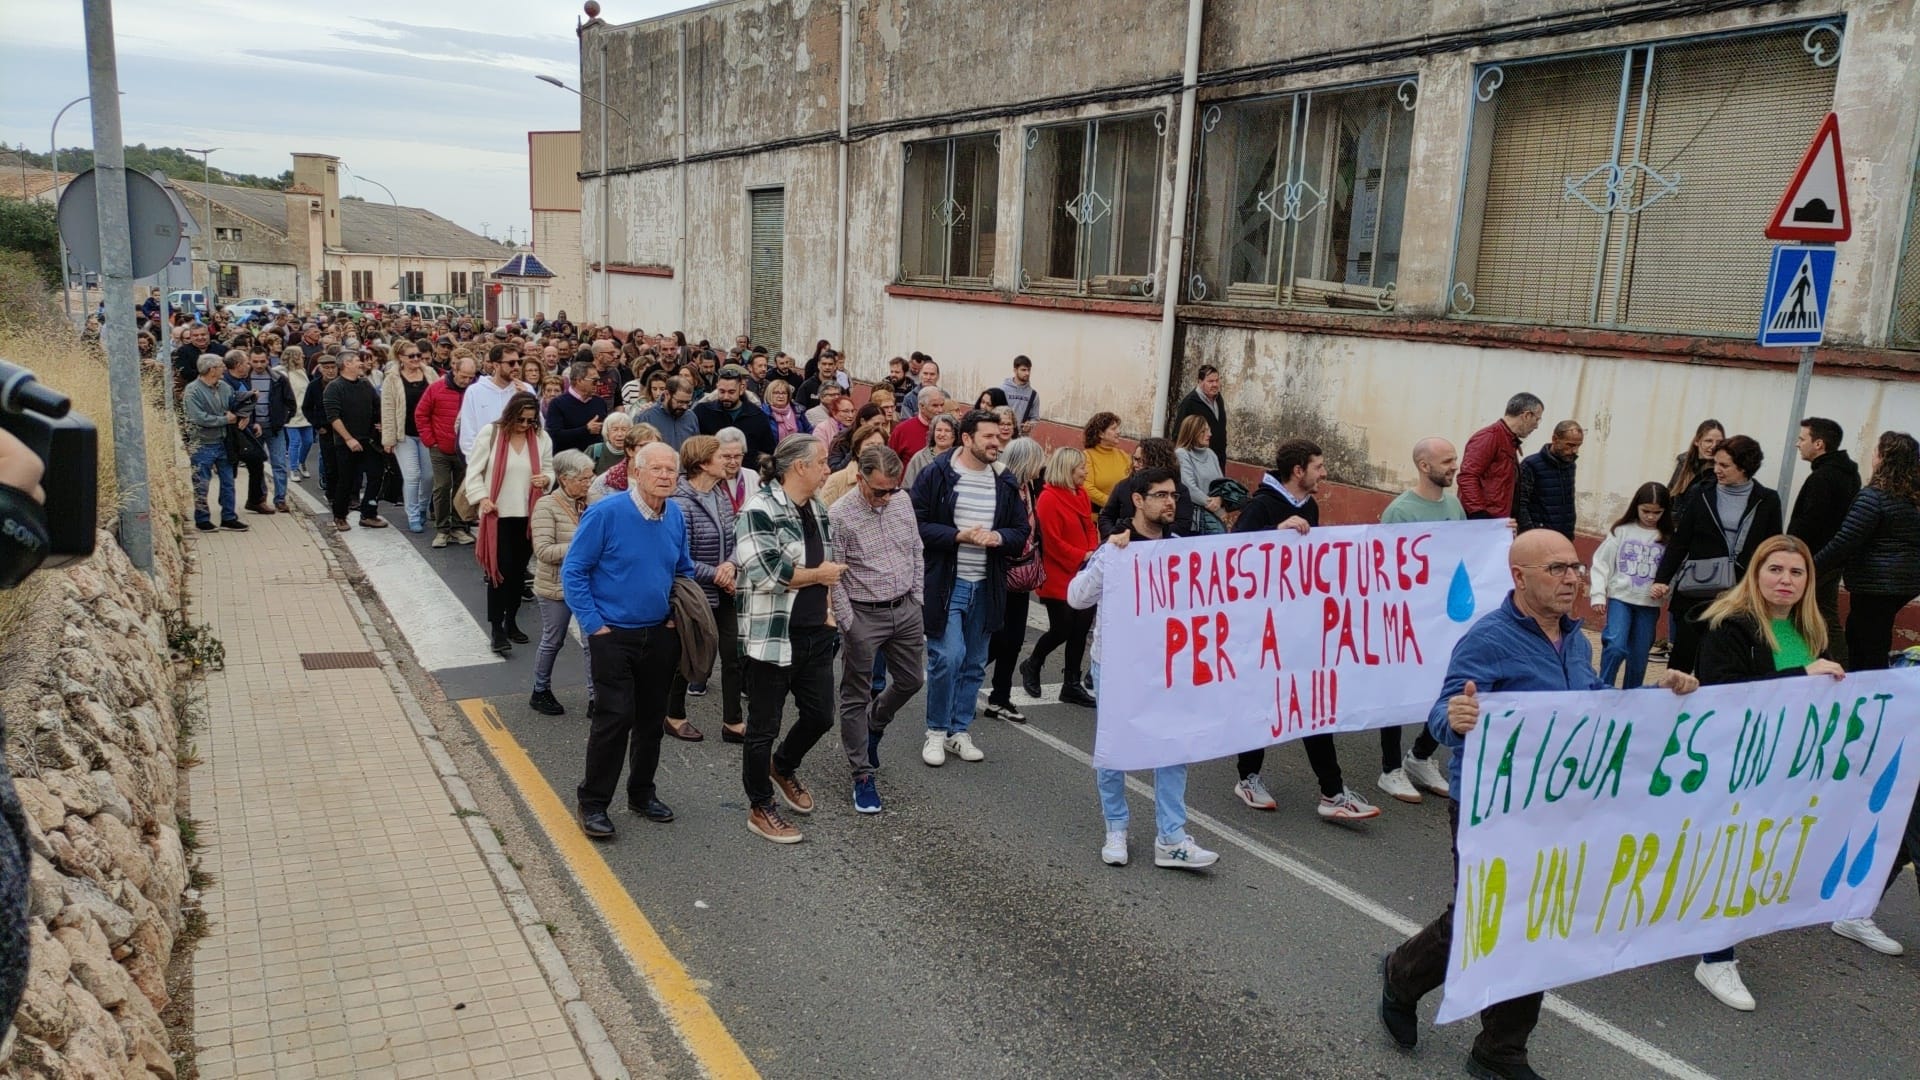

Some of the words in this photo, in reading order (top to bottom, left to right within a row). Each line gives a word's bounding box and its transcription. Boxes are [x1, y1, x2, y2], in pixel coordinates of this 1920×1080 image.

[1133, 534, 1431, 616] INFRAESTRUCTURES
[1164, 610, 1236, 688] PER
[1260, 607, 1281, 670] A
[1322, 597, 1423, 667] PALMA
[1271, 669, 1337, 738] JA!!!
[1648, 712, 1715, 797] ES
[1729, 706, 1786, 794] UN
[1788, 693, 1893, 780] DRET
[1461, 857, 1507, 970] NO
[1526, 841, 1587, 941] UN
